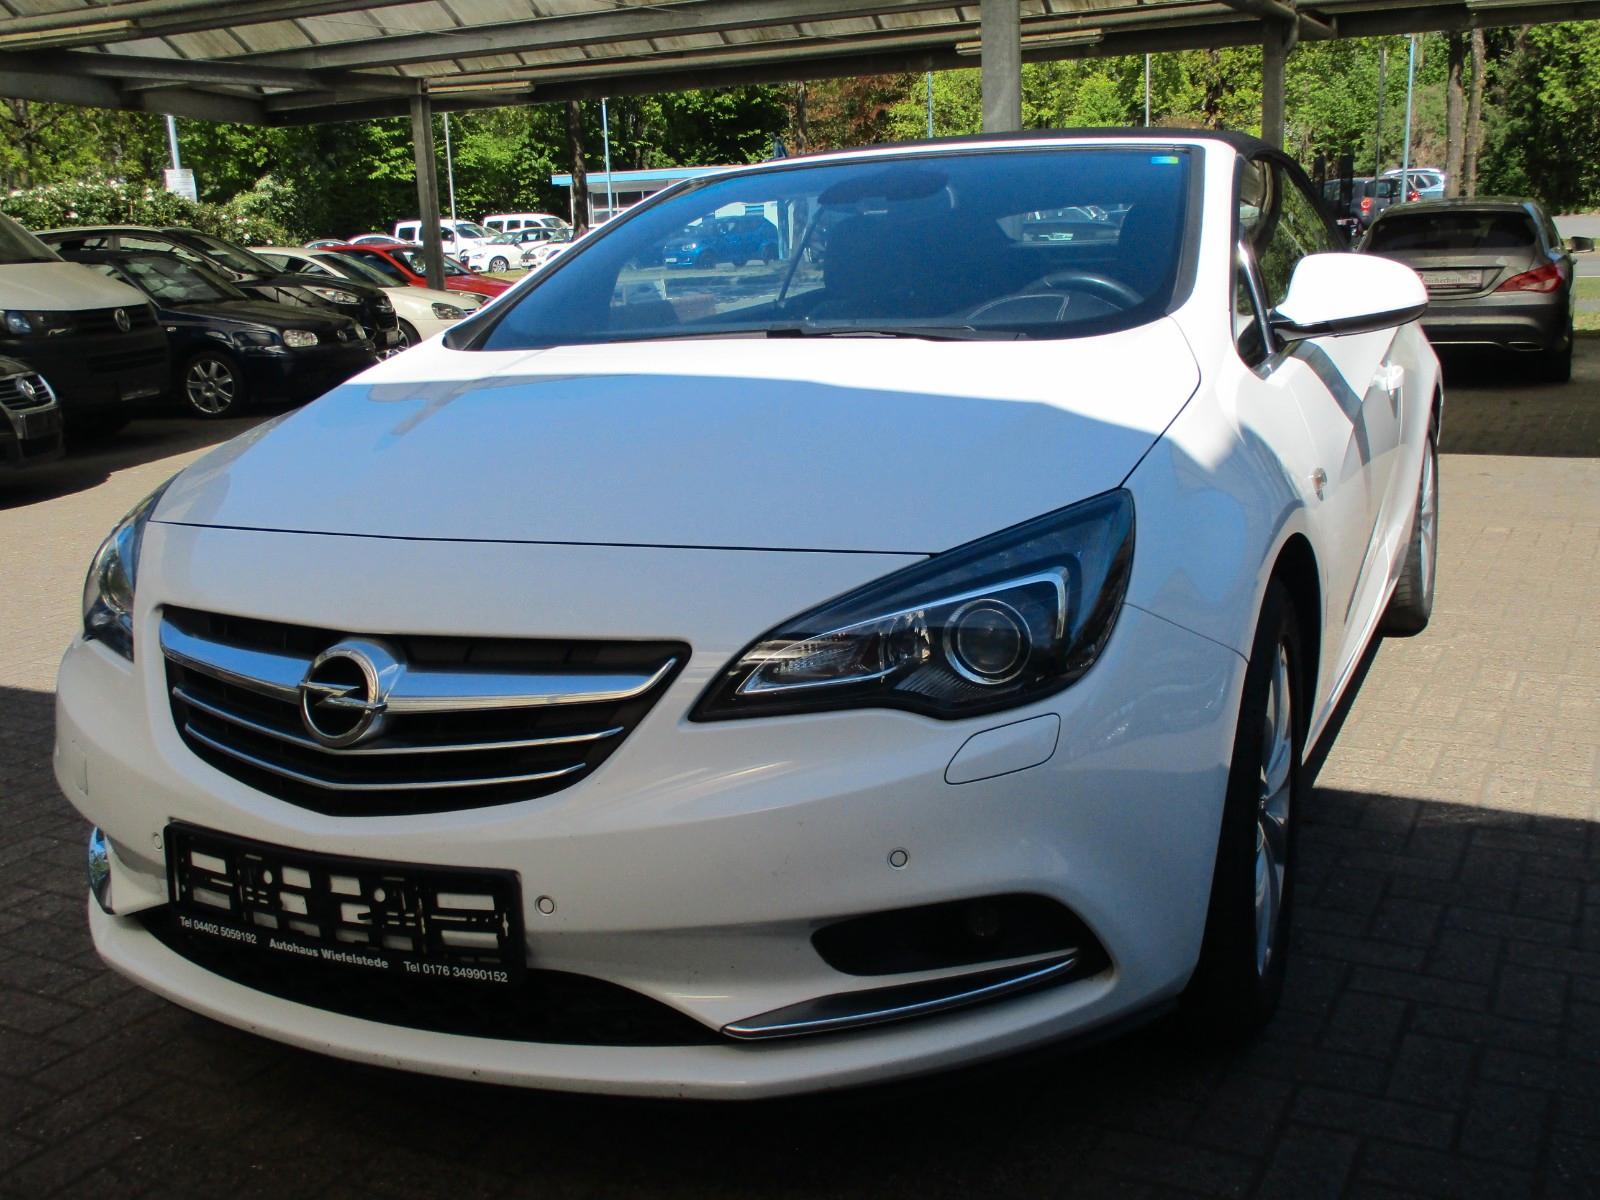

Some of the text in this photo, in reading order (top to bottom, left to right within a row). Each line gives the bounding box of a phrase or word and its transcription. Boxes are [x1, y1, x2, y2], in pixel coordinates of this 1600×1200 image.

[179, 915, 192, 928] Tel
[193, 919, 220, 935] 04402
[269, 938, 389, 969] Autohaus Wiefelstede
[403, 960, 508, 983] Tel 0176 34990152
